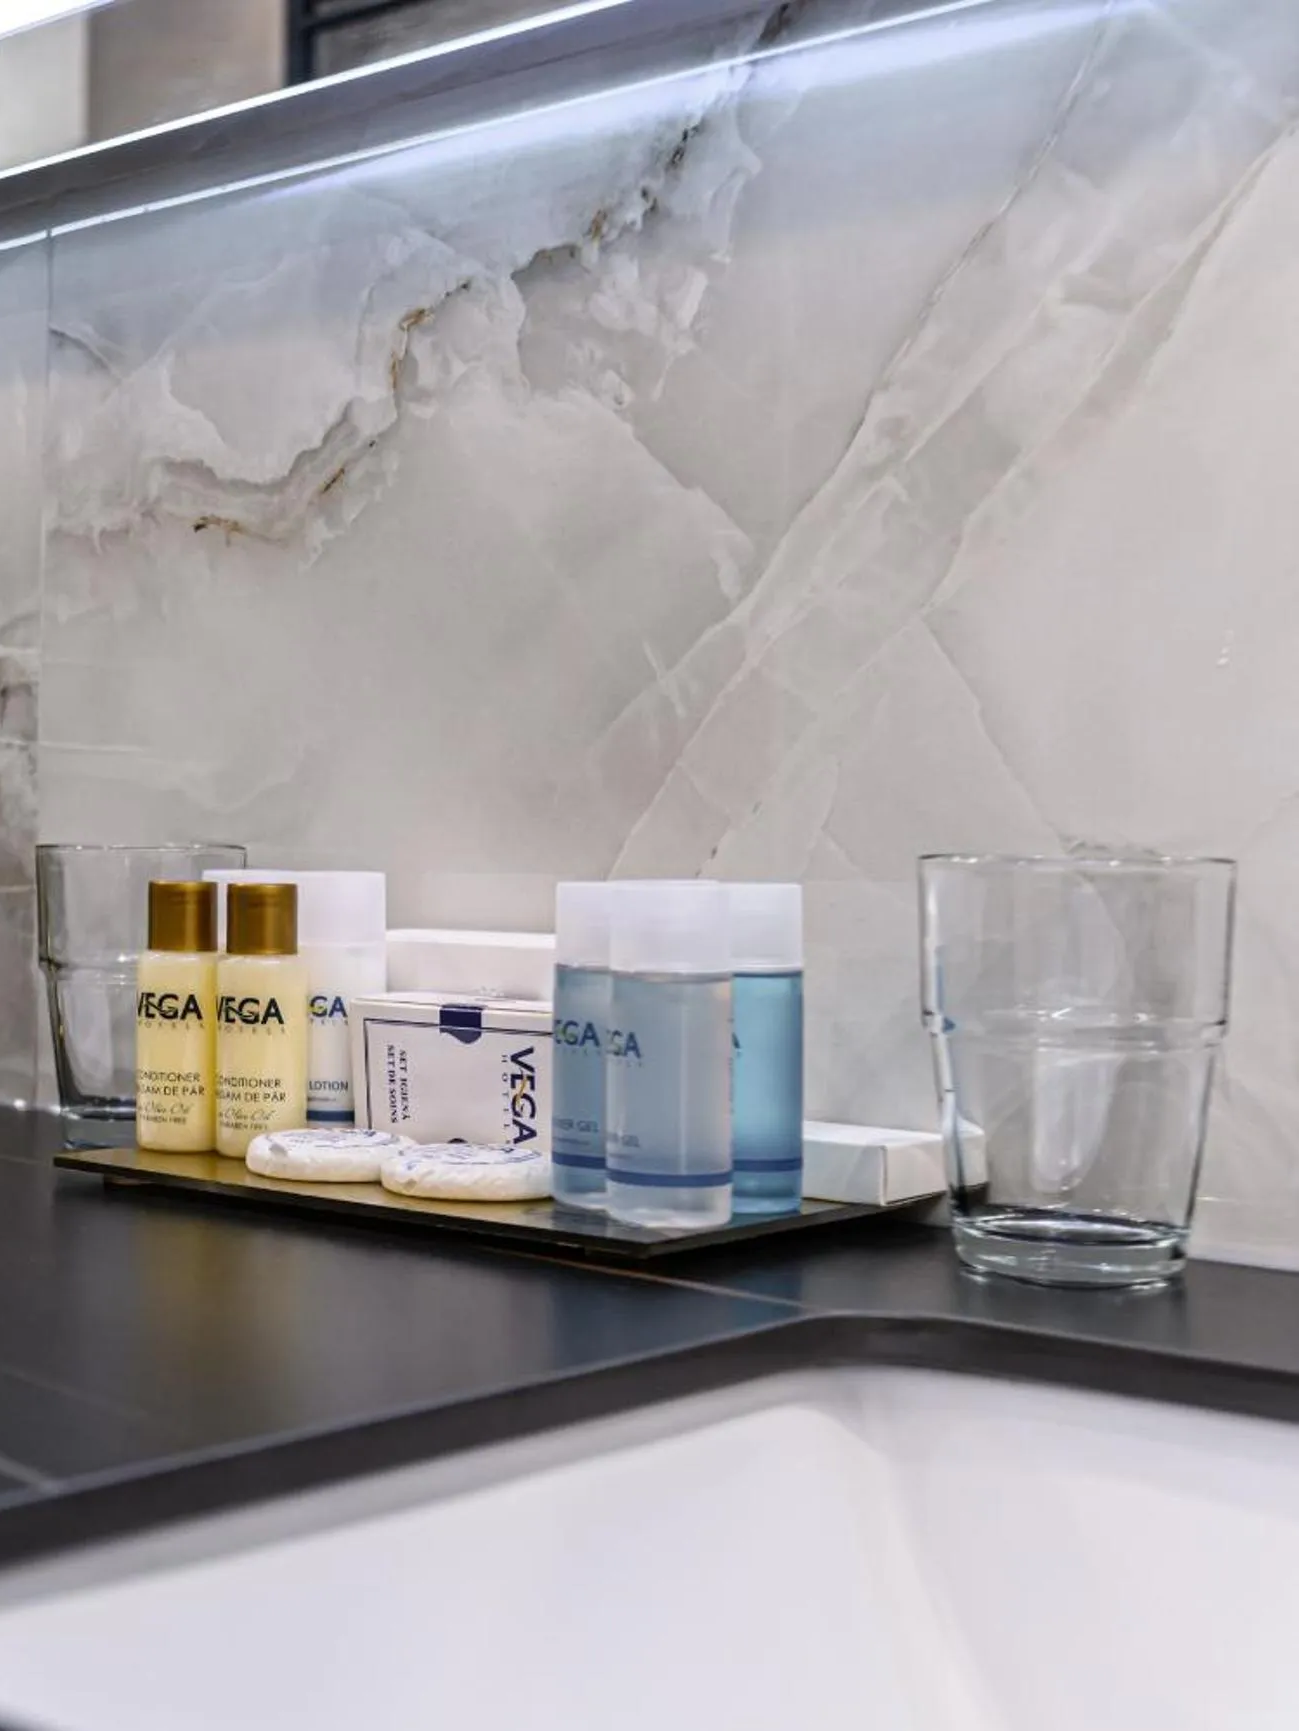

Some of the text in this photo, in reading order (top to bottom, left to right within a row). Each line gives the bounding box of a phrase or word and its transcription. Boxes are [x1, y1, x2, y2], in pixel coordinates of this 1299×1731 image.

[309, 995, 348, 1018] GA
[399, 1050, 408, 1073] SET
[163, 1085, 179, 1096] DE
[308, 1080, 349, 1092] LOTION
[387, 1045, 399, 1123] SET DE SOINS
[510, 1046, 538, 1145] VEGA
[244, 1091, 260, 1103] DE
